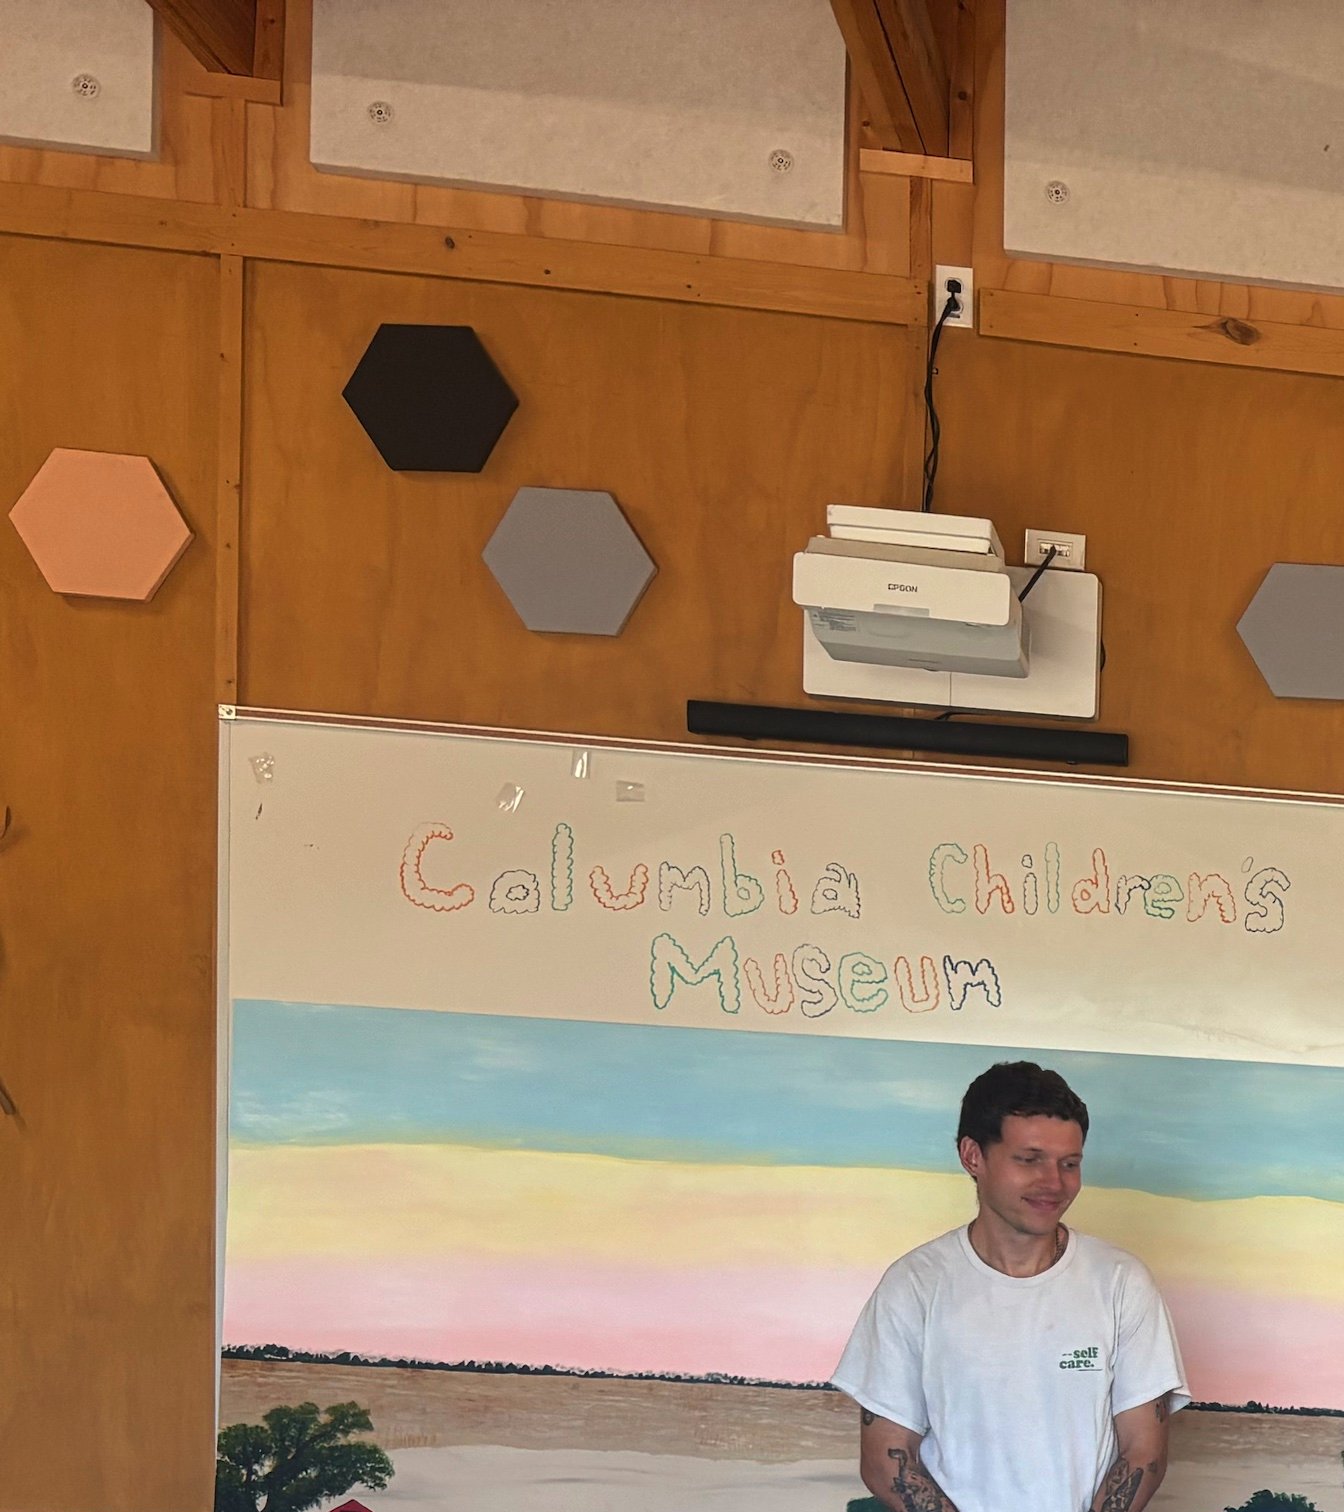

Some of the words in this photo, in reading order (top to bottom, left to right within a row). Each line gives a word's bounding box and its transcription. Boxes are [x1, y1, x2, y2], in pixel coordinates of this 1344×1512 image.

[887, 583, 918, 592] EPSON
[928, 841, 1291, 933] Children's
[650, 932, 1002, 1018] Museum
[1059, 1359, 1095, 1370] care.
